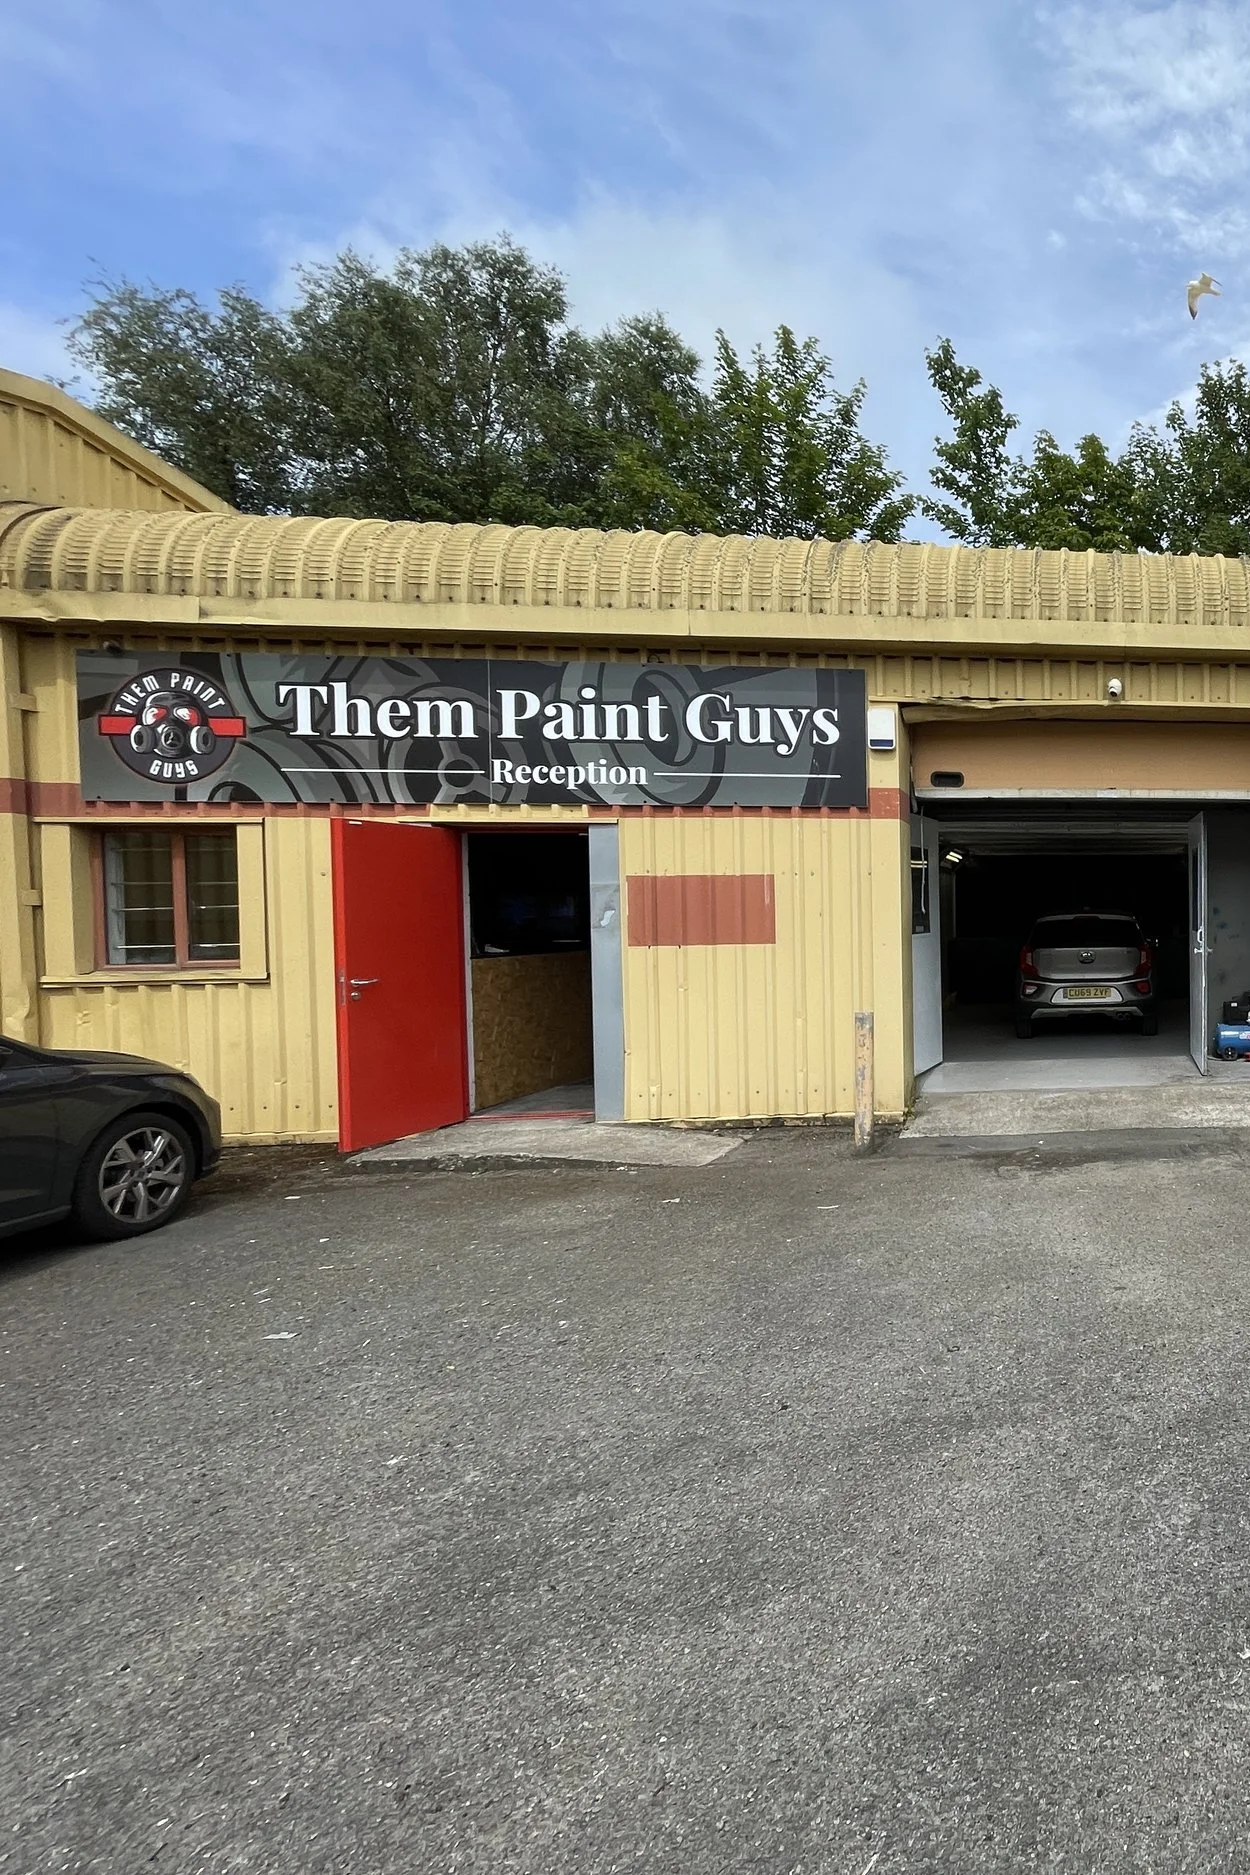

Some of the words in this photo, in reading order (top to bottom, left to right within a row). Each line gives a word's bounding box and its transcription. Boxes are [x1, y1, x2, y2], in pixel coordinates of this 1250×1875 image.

[114, 675, 160, 714] THEM
[170, 672, 226, 709] PAINT
[278, 681, 479, 738] Them
[496, 688, 669, 742] Paint
[685, 693, 840, 756] Guys
[149, 759, 199, 778] GUYS
[490, 758, 649, 790] Reception
[1068, 988, 1092, 997] CU69
